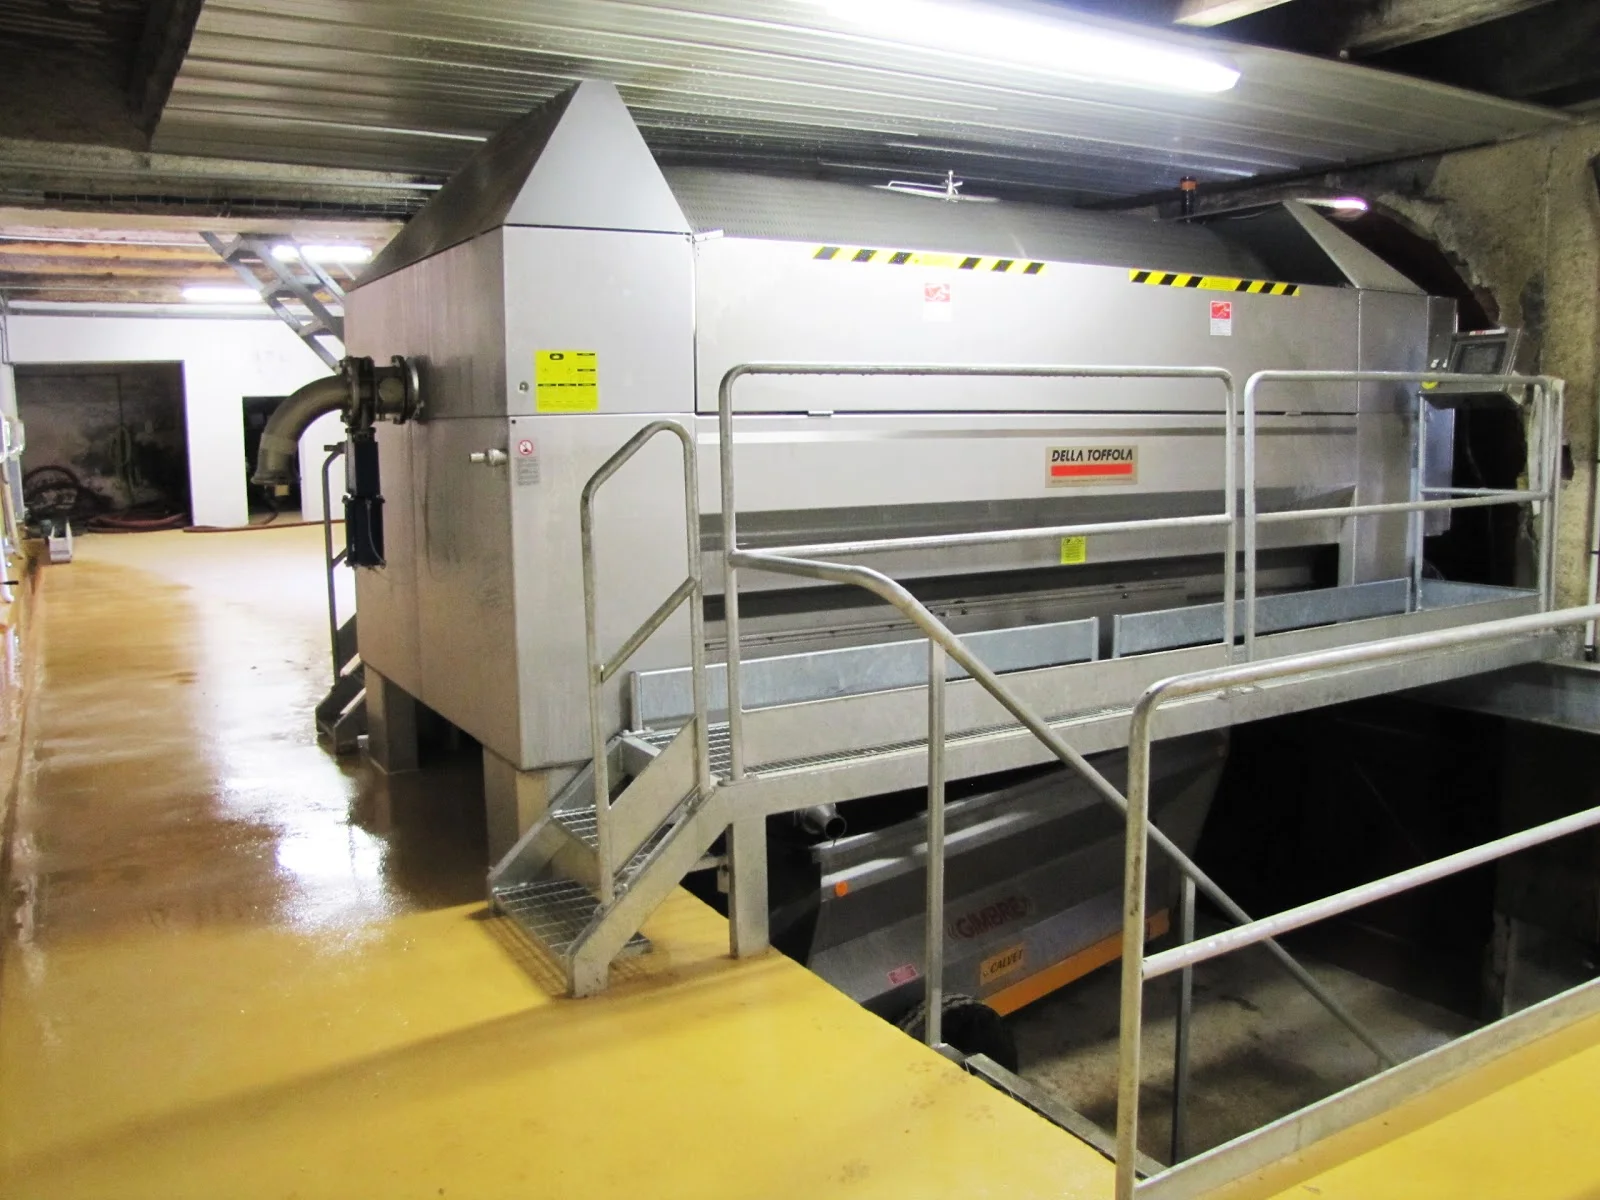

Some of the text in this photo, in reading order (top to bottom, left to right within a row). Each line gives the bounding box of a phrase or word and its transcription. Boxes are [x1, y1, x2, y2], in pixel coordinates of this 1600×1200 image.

[1052, 448, 1133, 462] DELLA TOFFOLA
[990, 948, 1024, 974] CALVET
